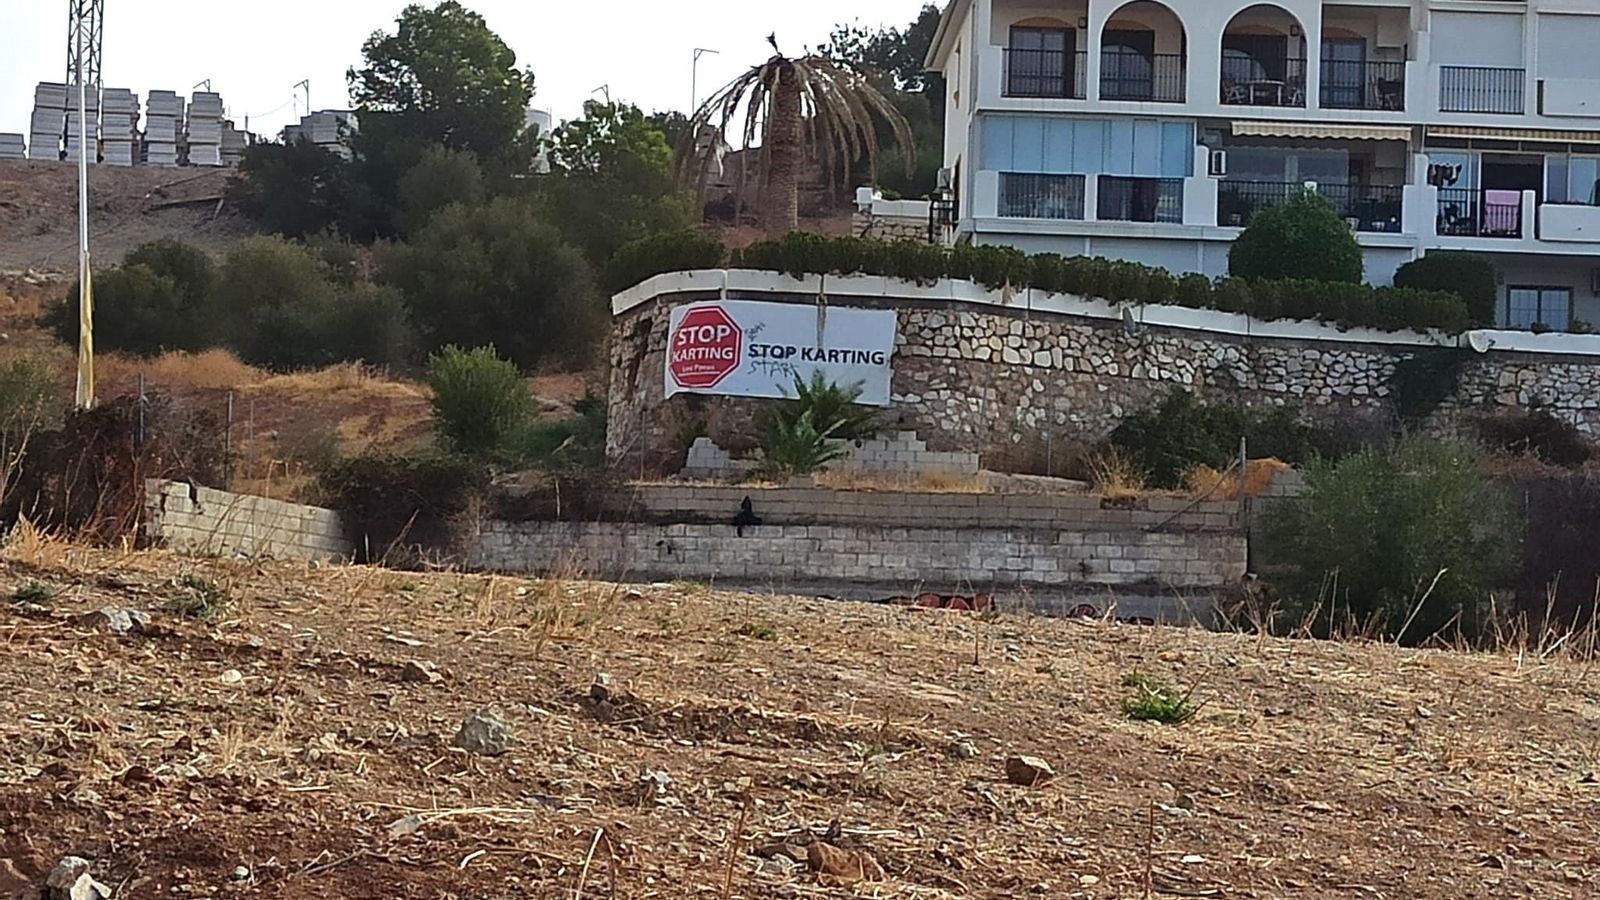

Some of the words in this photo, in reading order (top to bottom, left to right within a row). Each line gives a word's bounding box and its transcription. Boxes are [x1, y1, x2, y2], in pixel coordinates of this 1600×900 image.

[677, 324, 731, 346] STOP
[672, 347, 734, 363] KARTING
[748, 343, 796, 359] STOP
[801, 347, 884, 365] KARTING
